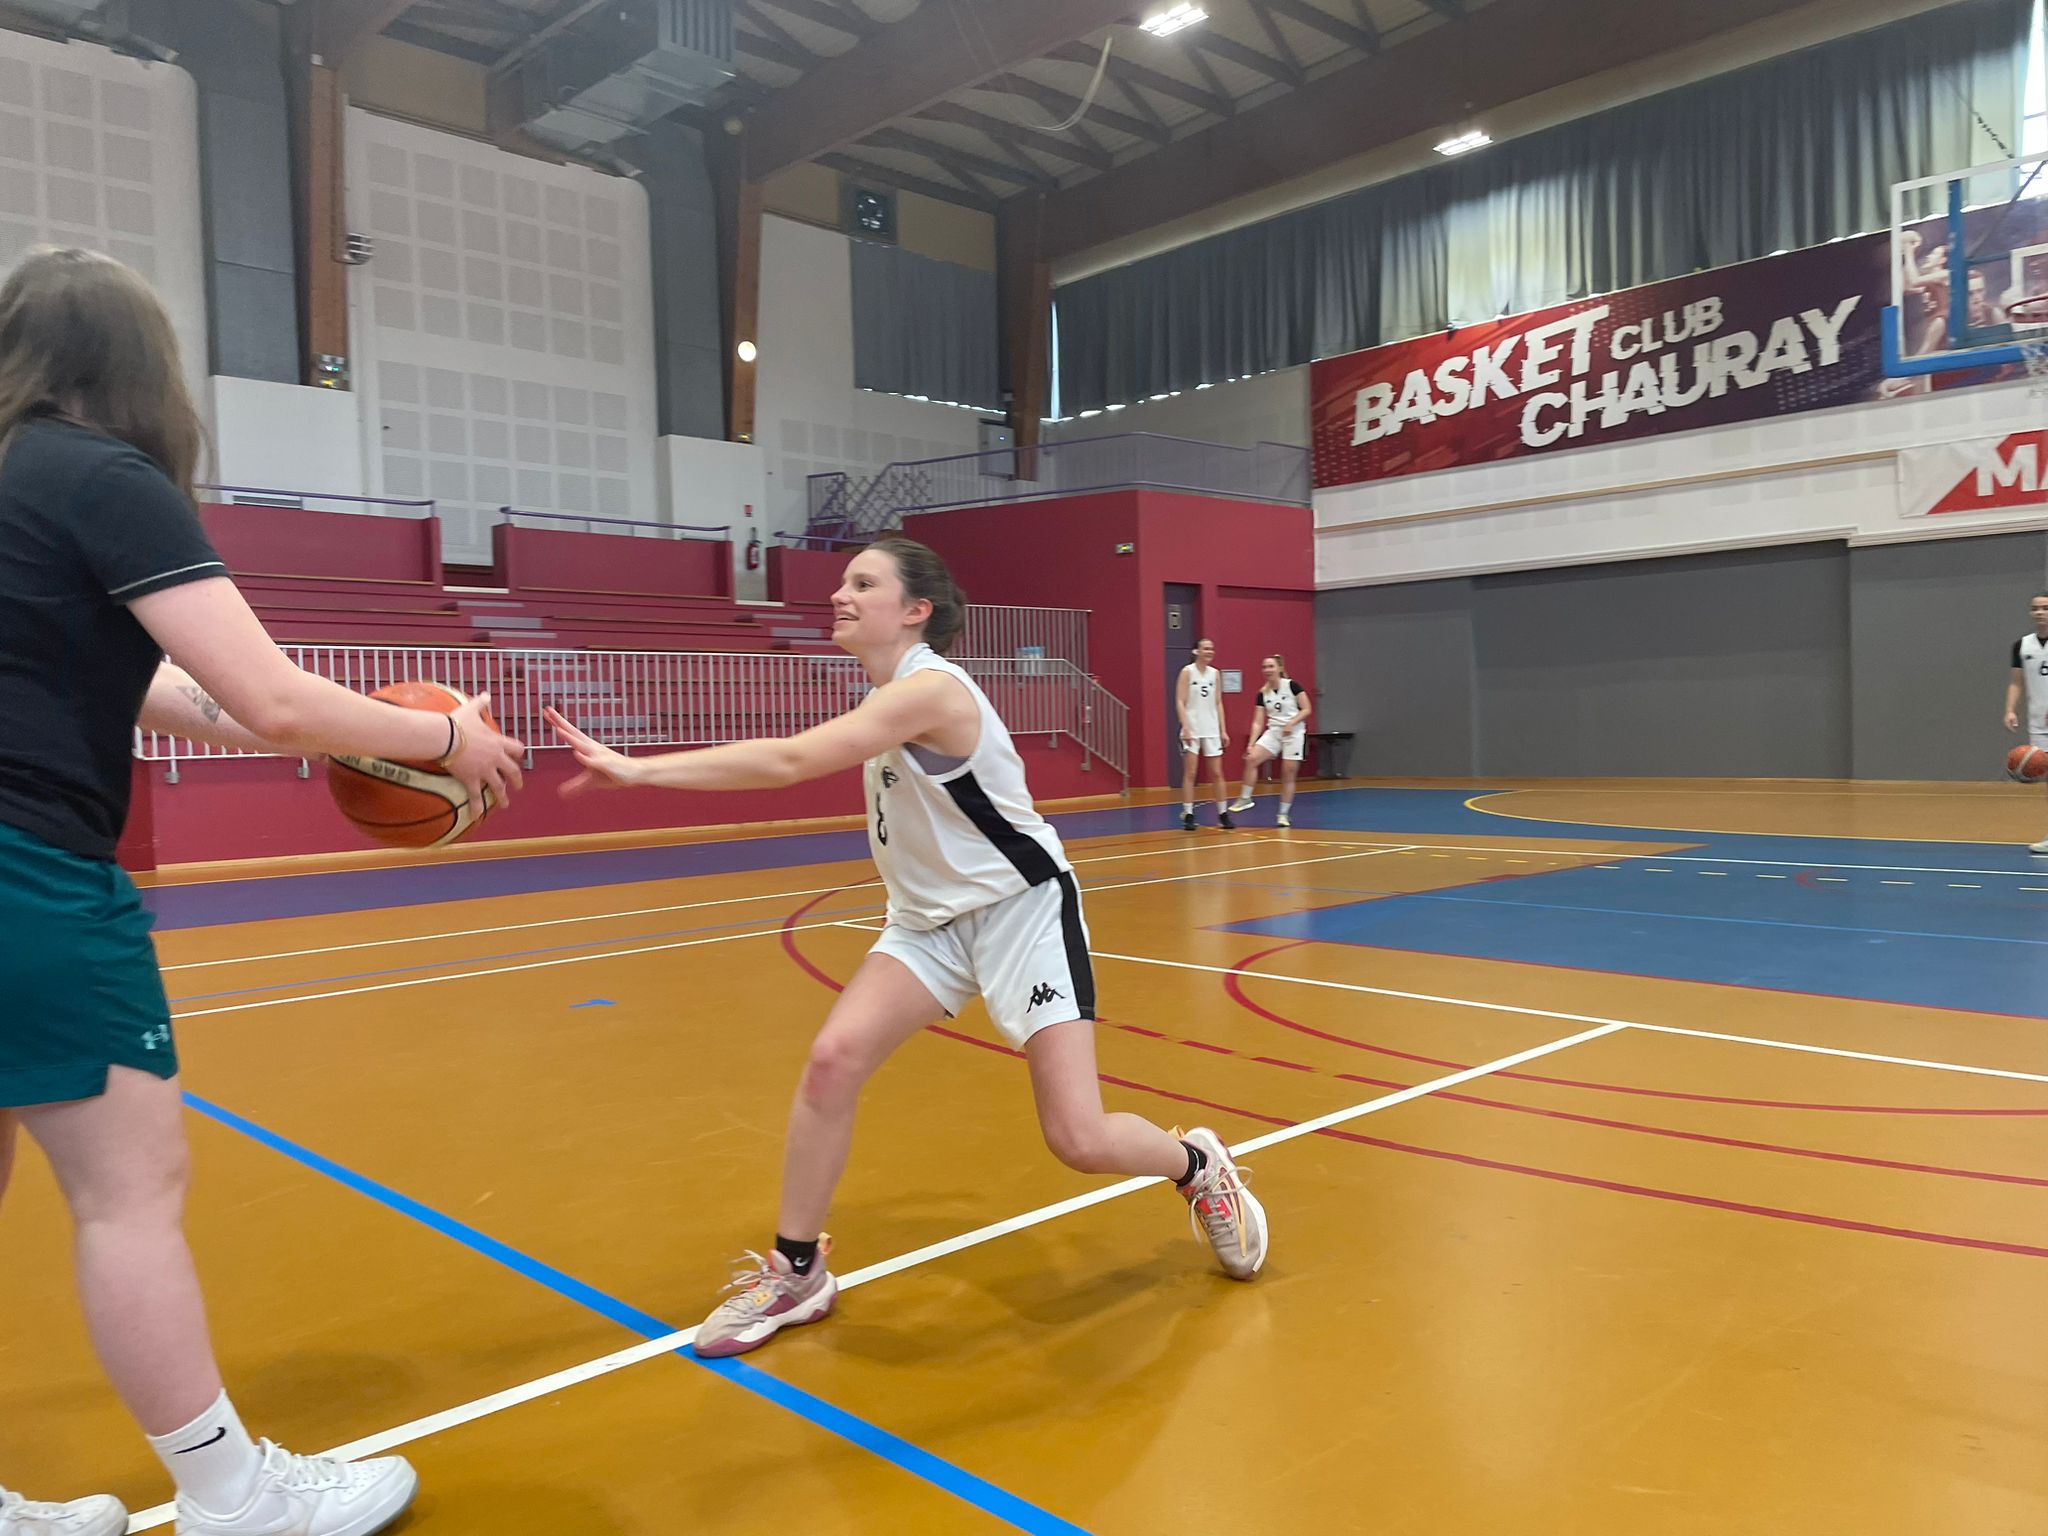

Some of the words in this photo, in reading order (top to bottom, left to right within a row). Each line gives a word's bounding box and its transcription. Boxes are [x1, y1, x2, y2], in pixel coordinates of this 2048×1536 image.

[1350, 304, 1610, 447] BASKET
[1609, 296, 1724, 360] CLUB
[1519, 294, 1863, 448] CHAURAY
[1975, 443, 2048, 497] M
[1200, 685, 1209, 698] 5
[1274, 702, 1282, 713] 9
